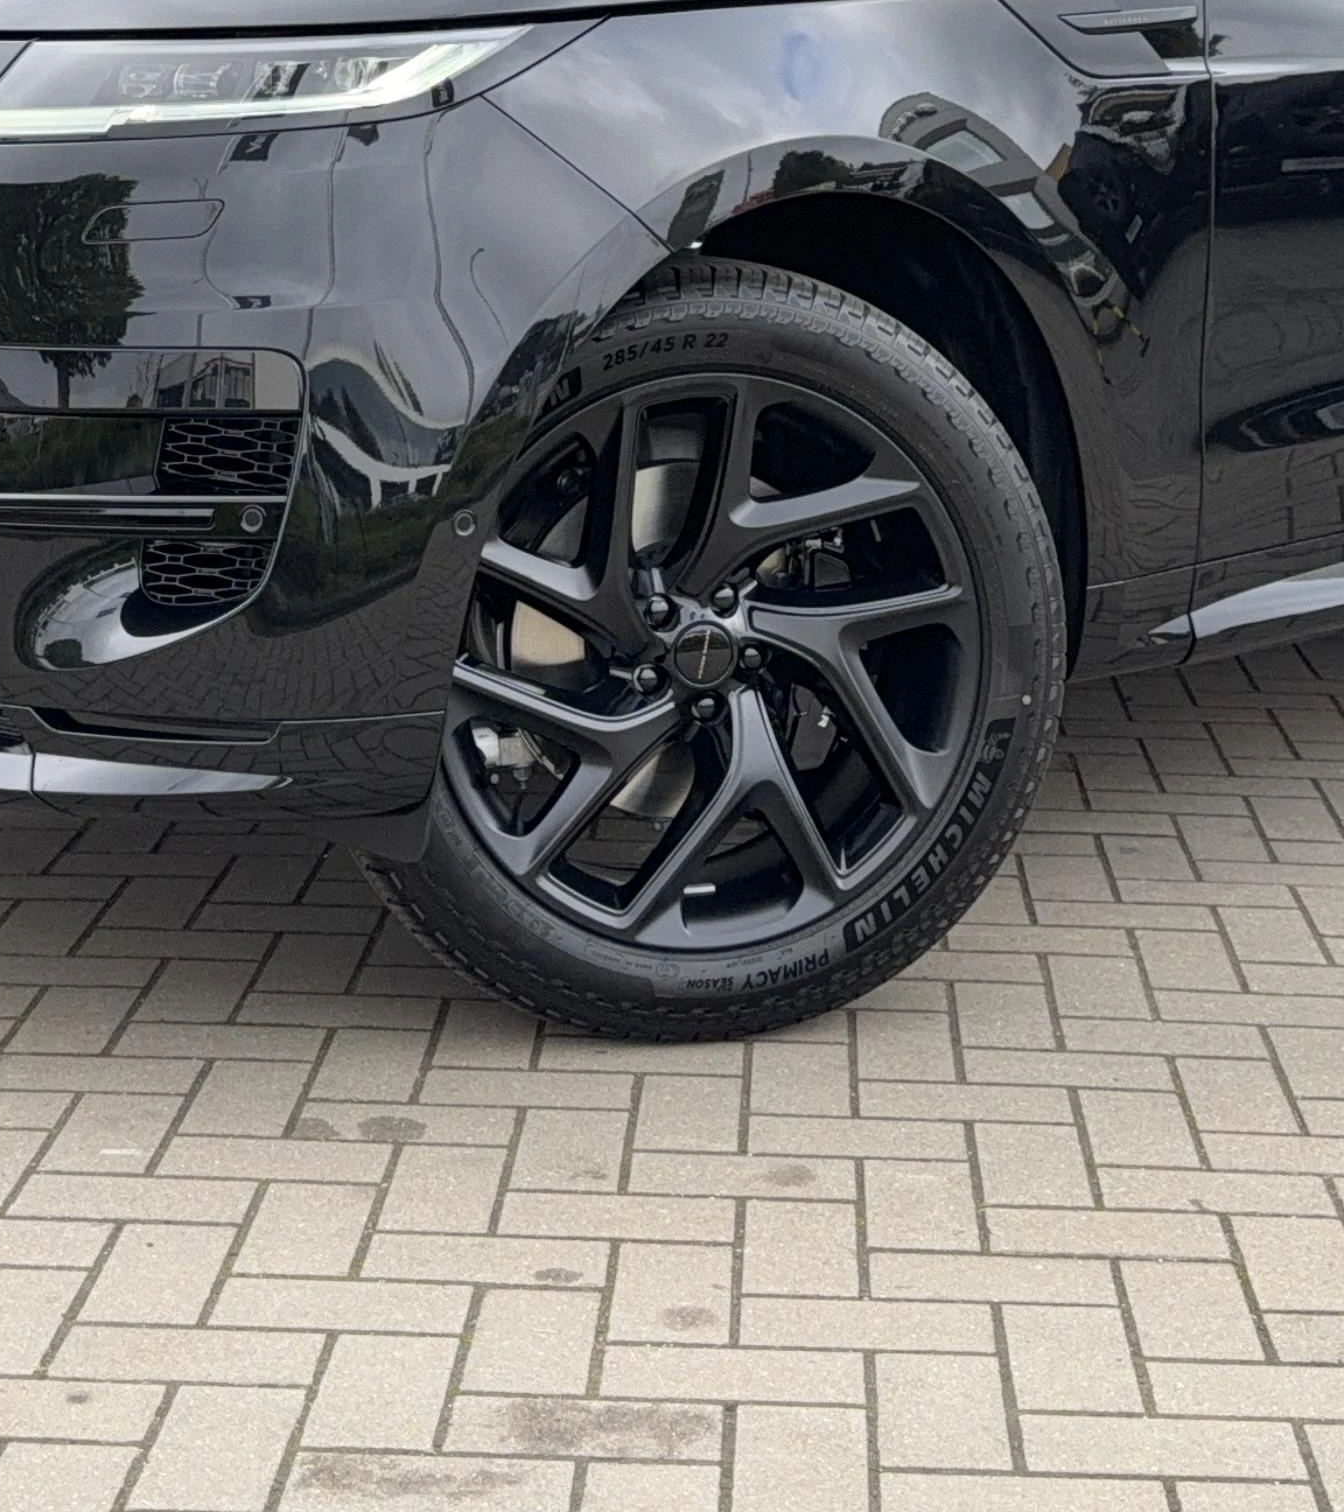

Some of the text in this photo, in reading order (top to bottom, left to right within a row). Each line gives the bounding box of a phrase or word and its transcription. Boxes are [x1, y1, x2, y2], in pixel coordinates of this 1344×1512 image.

[602, 332, 729, 371] 285/45 R 22
[853, 771, 993, 942] MICHELIN
[686, 976, 734, 989] SEASON
[744, 948, 830, 993] PRIMACY
